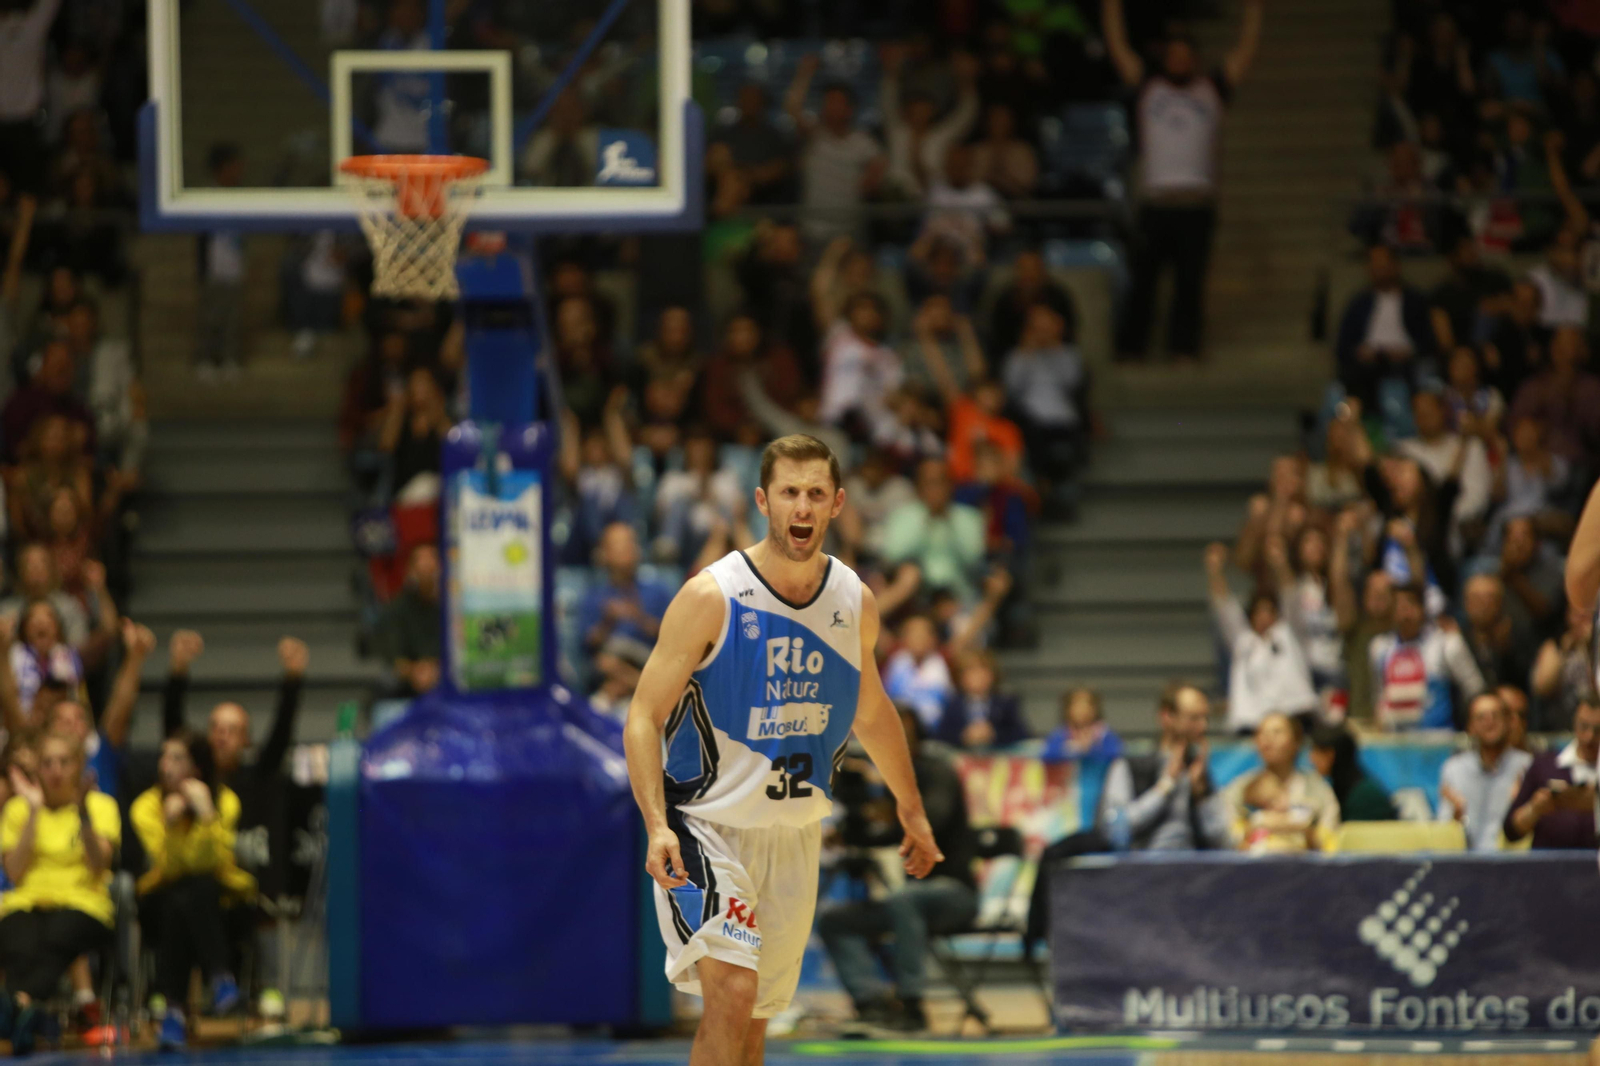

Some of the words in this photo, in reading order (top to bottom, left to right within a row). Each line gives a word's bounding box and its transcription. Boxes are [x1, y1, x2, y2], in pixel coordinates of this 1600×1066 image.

[766, 636, 824, 677] Rio
[766, 677, 820, 701] Natura
[765, 752, 813, 801] 32
[1122, 985, 1350, 1028] Multiusos
[1369, 986, 1530, 1031] Fontes
[1547, 985, 1600, 1031] do
